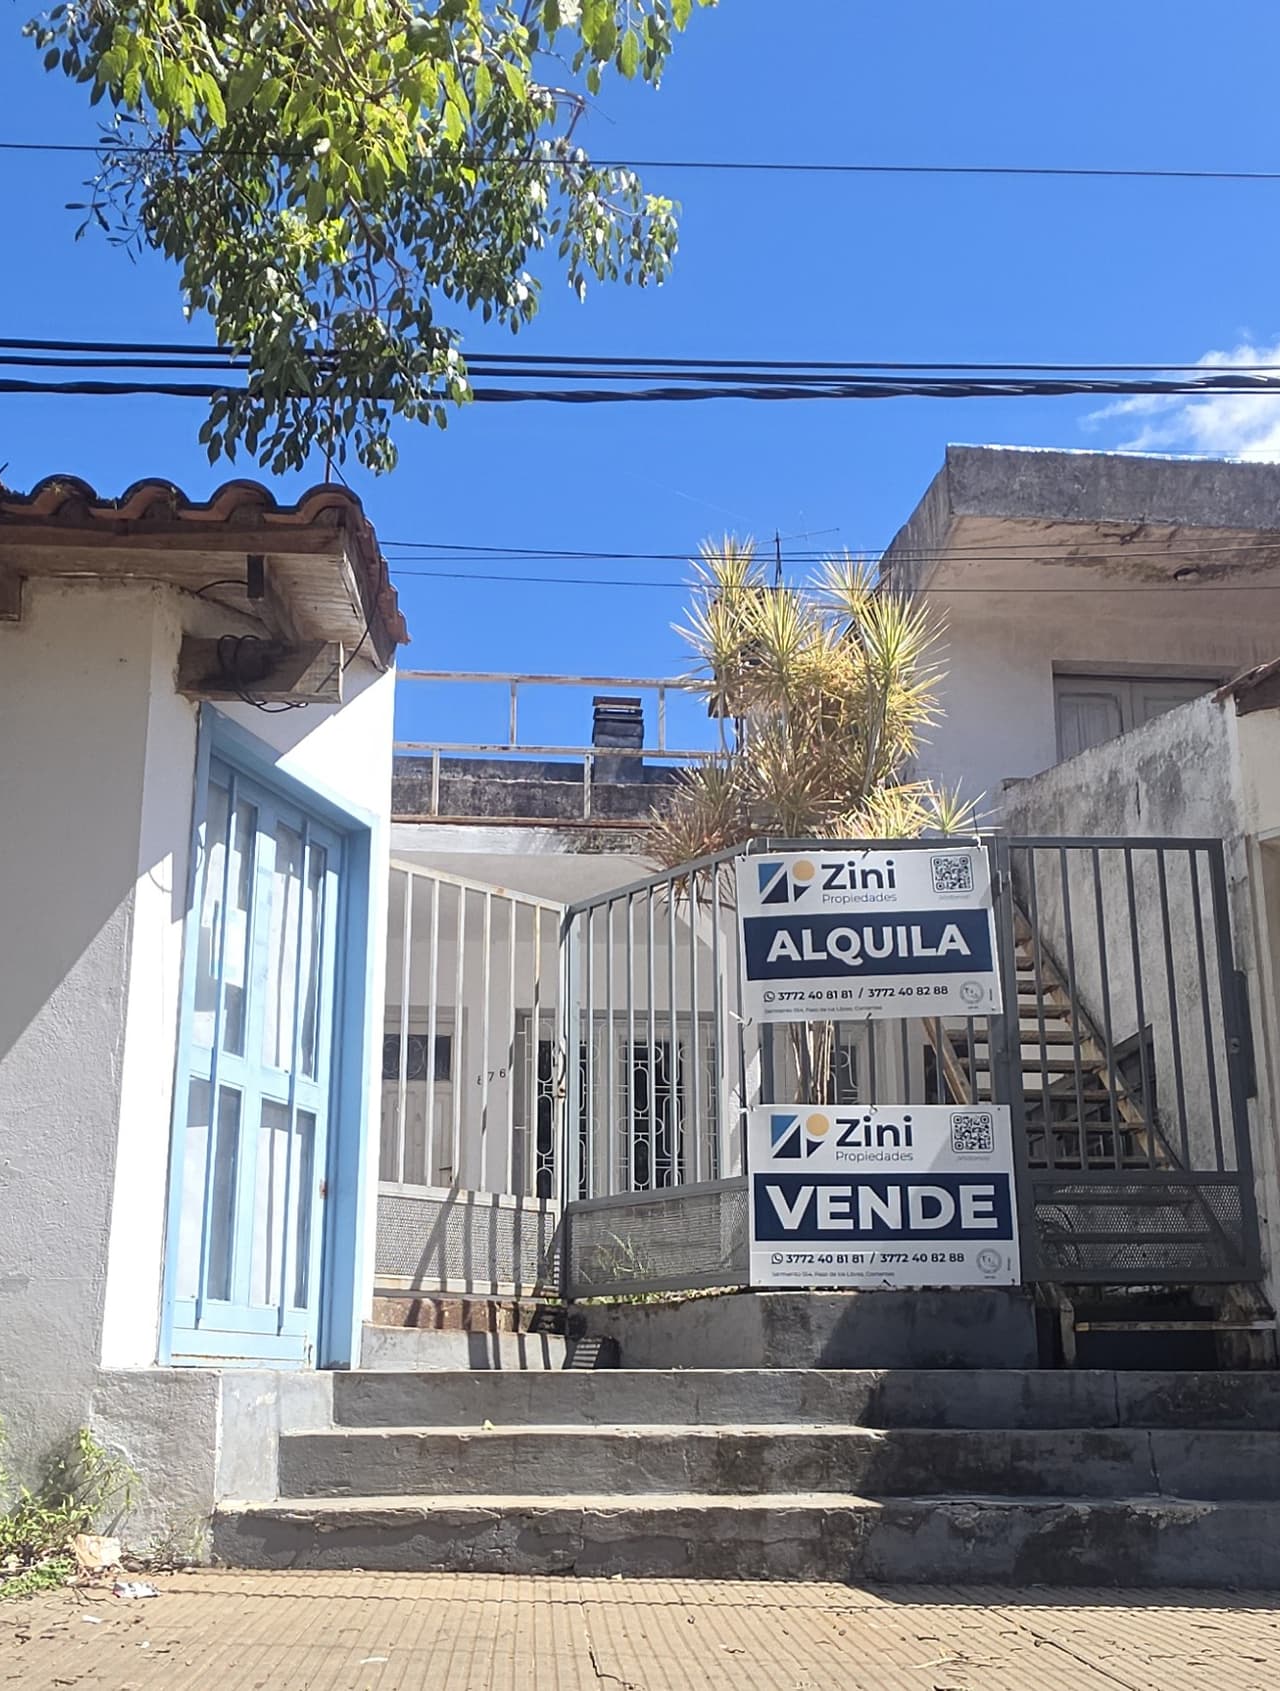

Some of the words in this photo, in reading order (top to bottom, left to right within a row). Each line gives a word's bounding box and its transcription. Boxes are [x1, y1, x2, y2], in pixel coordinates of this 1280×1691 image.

[821, 860, 897, 890] Zini
[823, 892, 898, 905] Propiedades
[767, 923, 972, 966] ALQUILA
[777, 991, 805, 1000] 3772
[808, 990, 823, 1000] 40
[826, 990, 838, 999] 81
[841, 989, 853, 999] 81
[868, 988, 896, 998] 3772
[899, 987, 914, 997] 40
[917, 986, 931, 996] 82
[934, 985, 949, 996] 88
[835, 1115, 913, 1148] Zini
[836, 1151, 914, 1163] Propiedades
[765, 1184, 999, 1230] VENDE
[786, 1253, 815, 1263] 3772
[817, 1253, 833, 1263] 40
[837, 1253, 849, 1263] 81
[852, 1253, 865, 1263] 81
[880, 1253, 909, 1263] 3772
[912, 1253, 928, 1263] 40
[931, 1252, 946, 1263] 82
[949, 1252, 965, 1263] 88
